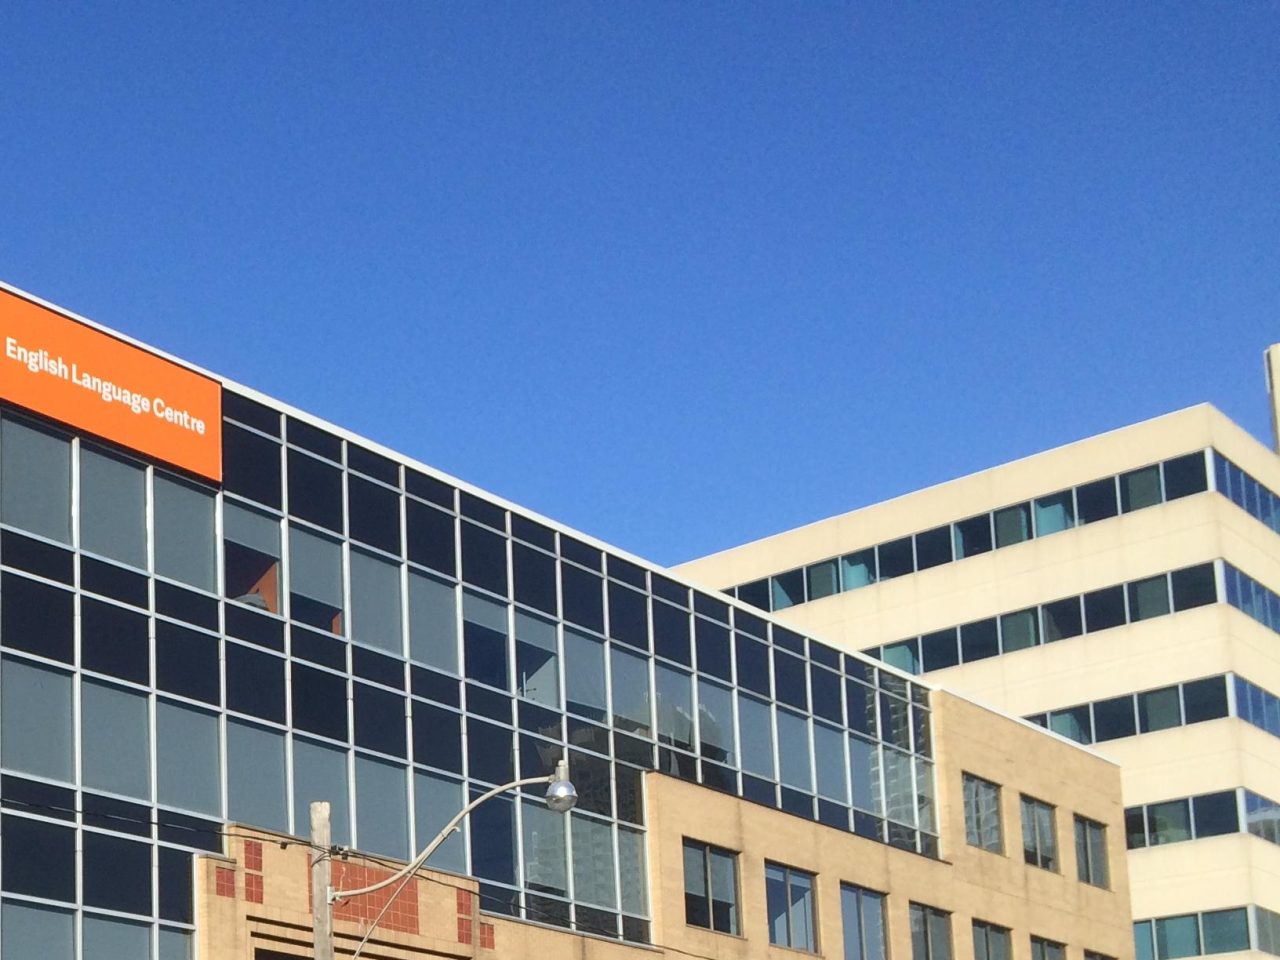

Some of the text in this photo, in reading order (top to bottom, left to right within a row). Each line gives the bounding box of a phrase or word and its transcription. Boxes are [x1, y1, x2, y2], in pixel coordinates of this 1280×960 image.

[6, 337, 206, 436] English Language Centre
